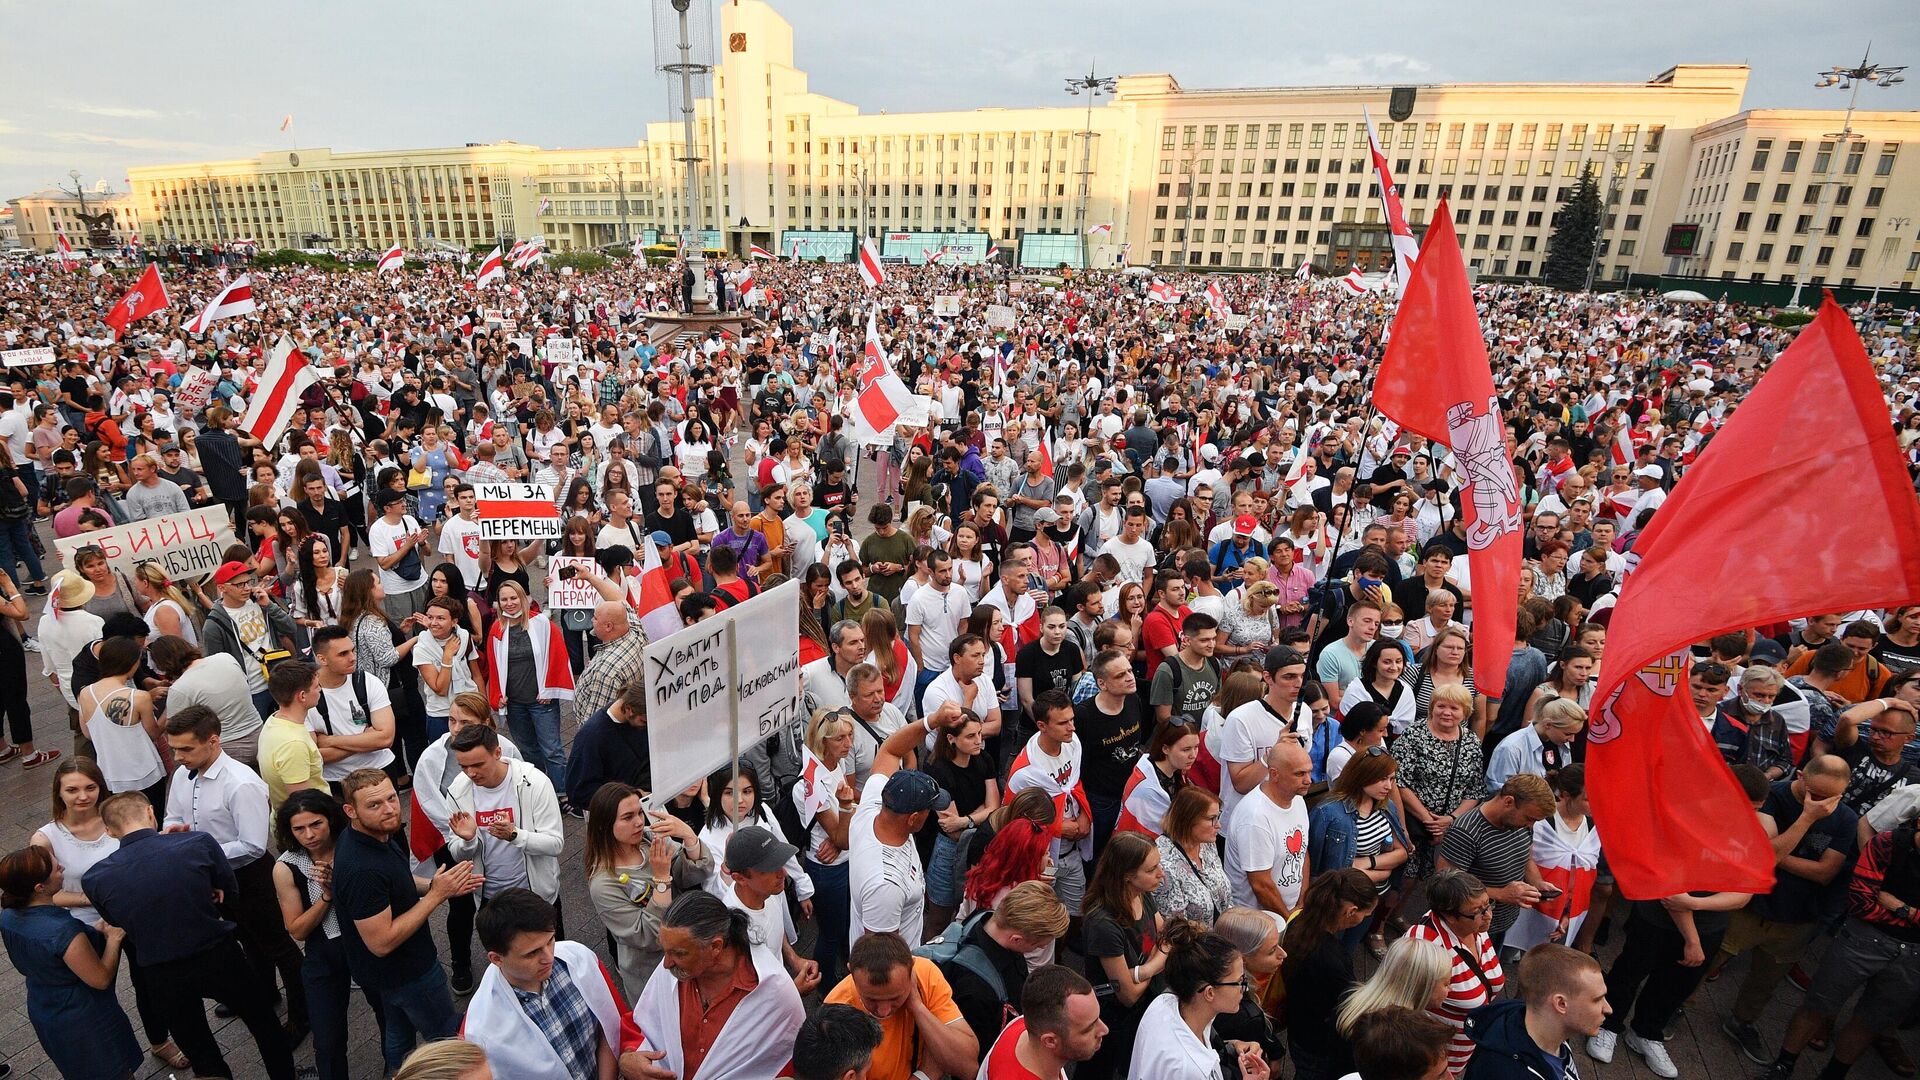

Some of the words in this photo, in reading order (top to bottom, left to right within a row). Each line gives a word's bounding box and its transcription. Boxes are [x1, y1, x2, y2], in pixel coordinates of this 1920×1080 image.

[186, 383, 205, 395] НЕ
[483, 486, 512, 499] МЫ
[523, 484, 546, 500] ЗА
[481, 519, 561, 537] ПЕРЕМЕНЫ
[656, 655, 720, 706] ПЛЯСАТЬ
[1050, 668, 1067, 678] DON'T
[688, 676, 726, 711] ПОД
[1184, 689, 1195, 704] LOS
[759, 695, 798, 737] БИТ!
